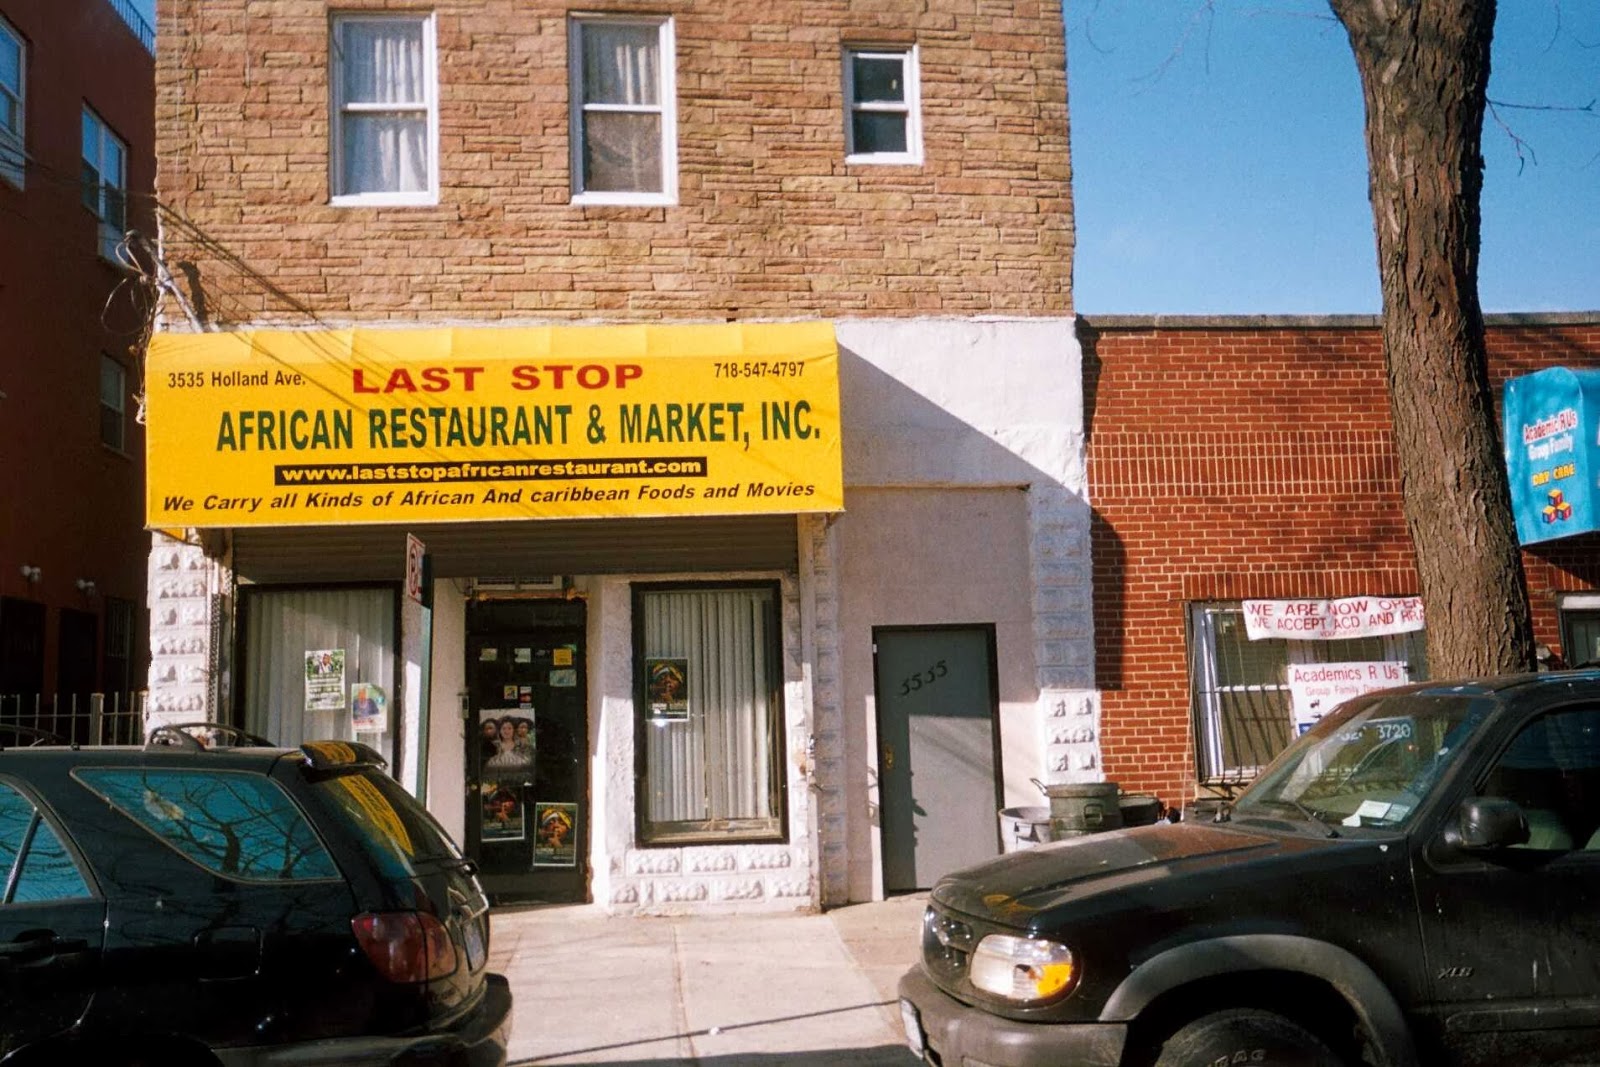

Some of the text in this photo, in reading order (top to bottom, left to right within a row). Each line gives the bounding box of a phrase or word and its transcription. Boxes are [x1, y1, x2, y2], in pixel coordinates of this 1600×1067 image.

[168, 370, 306, 388] 3535 Holland Ave.
[352, 364, 644, 394] LAST STOP
[714, 361, 805, 378] 718-547-4797
[216, 399, 821, 452] AFRICAN RESTAURANT & MARKET, INC.
[281, 459, 702, 483] www.laststopafricanrestaurant.com
[163, 481, 816, 513] We Carry all Kinds of African And caribbean Foods and Movies
[1246, 603, 1273, 616] WE
[1285, 603, 1320, 616] ARE
[1327, 600, 1368, 616] NOW
[1252, 617, 1271, 629] WE
[1277, 617, 1327, 631] ACCEPT
[1334, 615, 1361, 630] ACD
[1369, 612, 1395, 627] AND
[1294, 664, 1399, 683] Academics R Us
